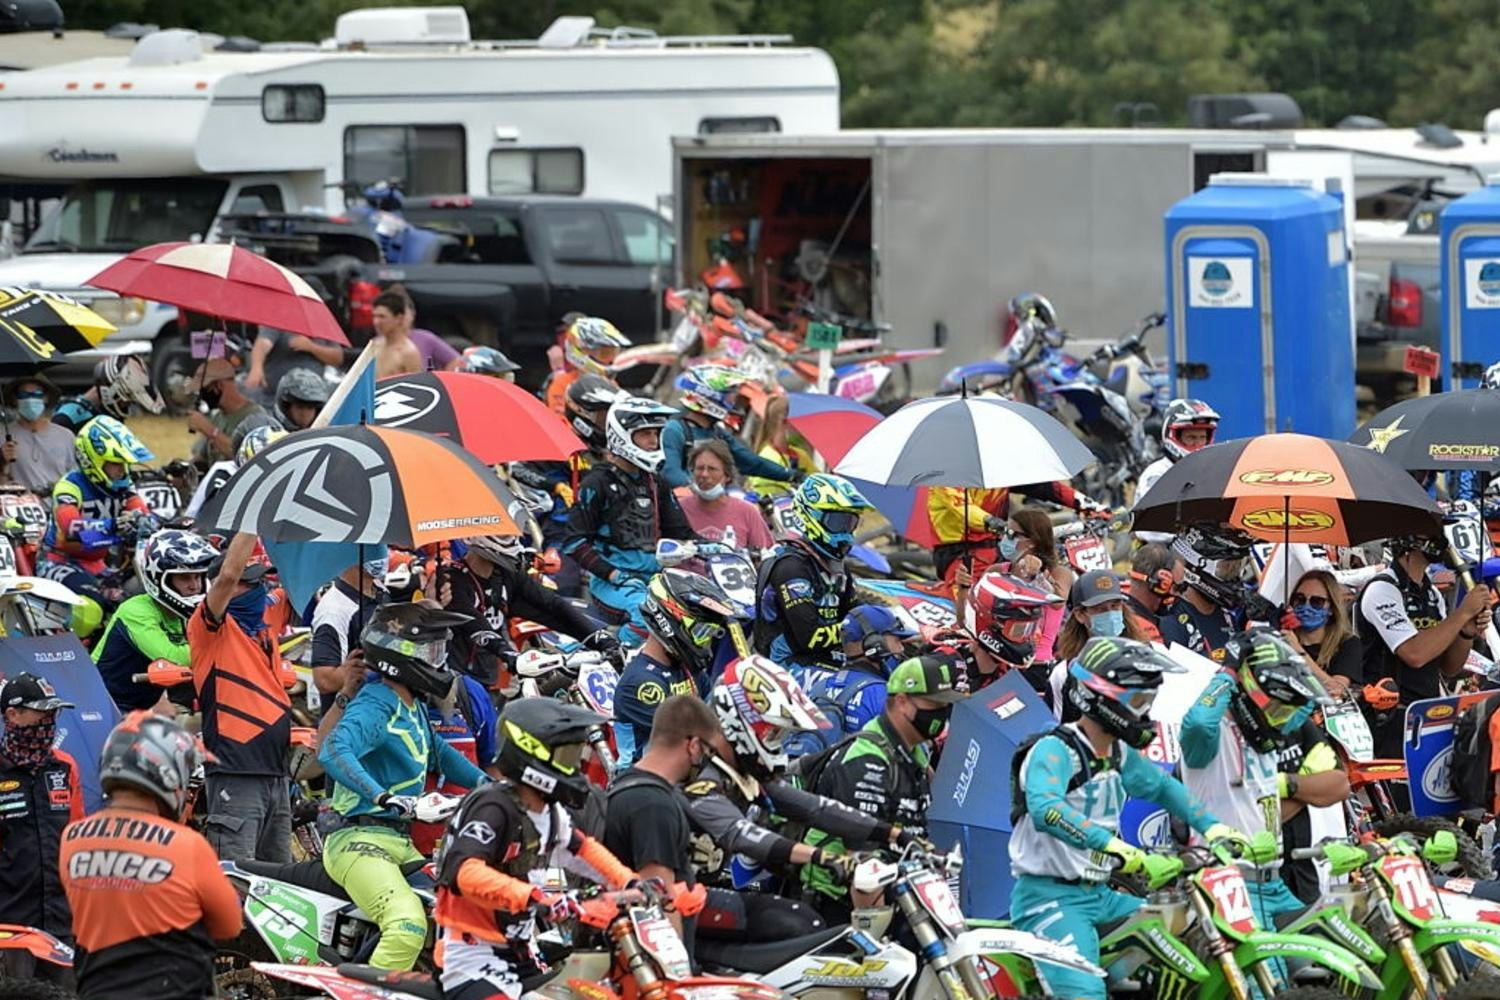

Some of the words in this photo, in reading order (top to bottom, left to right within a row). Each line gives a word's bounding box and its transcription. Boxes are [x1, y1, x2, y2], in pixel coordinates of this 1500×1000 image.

[1428, 443, 1500, 458] ROCKSTAR
[1246, 469, 1331, 485] FMF
[66, 818, 175, 847] BOLTON
[68, 849, 174, 885] GNCC
